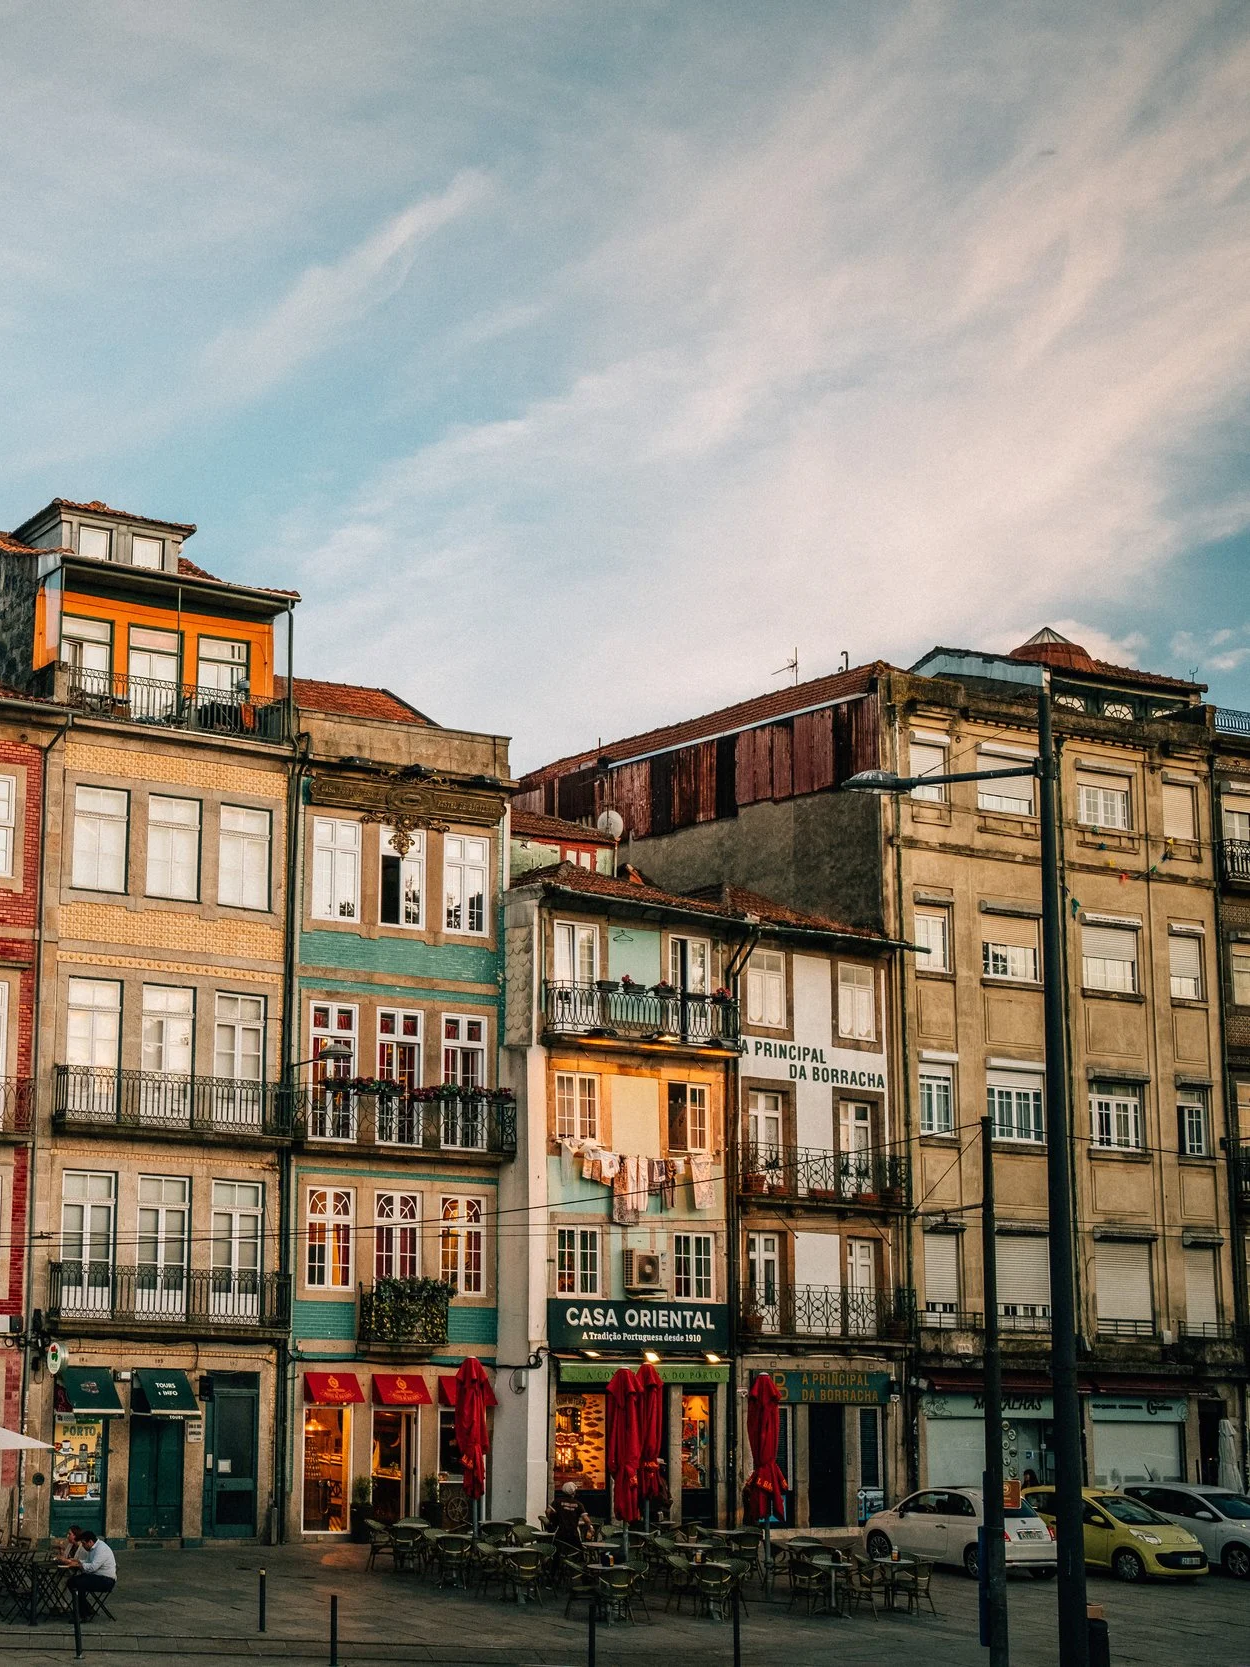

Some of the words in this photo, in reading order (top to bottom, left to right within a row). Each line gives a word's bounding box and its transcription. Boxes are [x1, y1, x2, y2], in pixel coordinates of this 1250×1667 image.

[742, 1039, 749, 1055] A
[755, 1041, 827, 1064] PRINCIPAL
[789, 1064, 807, 1080] DA
[812, 1067, 885, 1089] BORRACHA
[566, 1307, 619, 1328] CASA
[625, 1308, 716, 1330] ORIENTAL
[582, 1332, 589, 1340] A
[588, 1331, 621, 1342] Tradição
[622, 1332, 664, 1343] Portuguesa
[664, 1333, 685, 1342] desde
[685, 1334, 702, 1343] 1910
[673, 1372, 685, 1380] DO
[690, 1371, 721, 1380] PORTO
[801, 1373, 808, 1385] A
[812, 1373, 870, 1387] PRINCIPAL
[801, 1389, 815, 1401] DA
[820, 1389, 879, 1402] BORRACHA
[62, 1425, 97, 1437] PORTO
